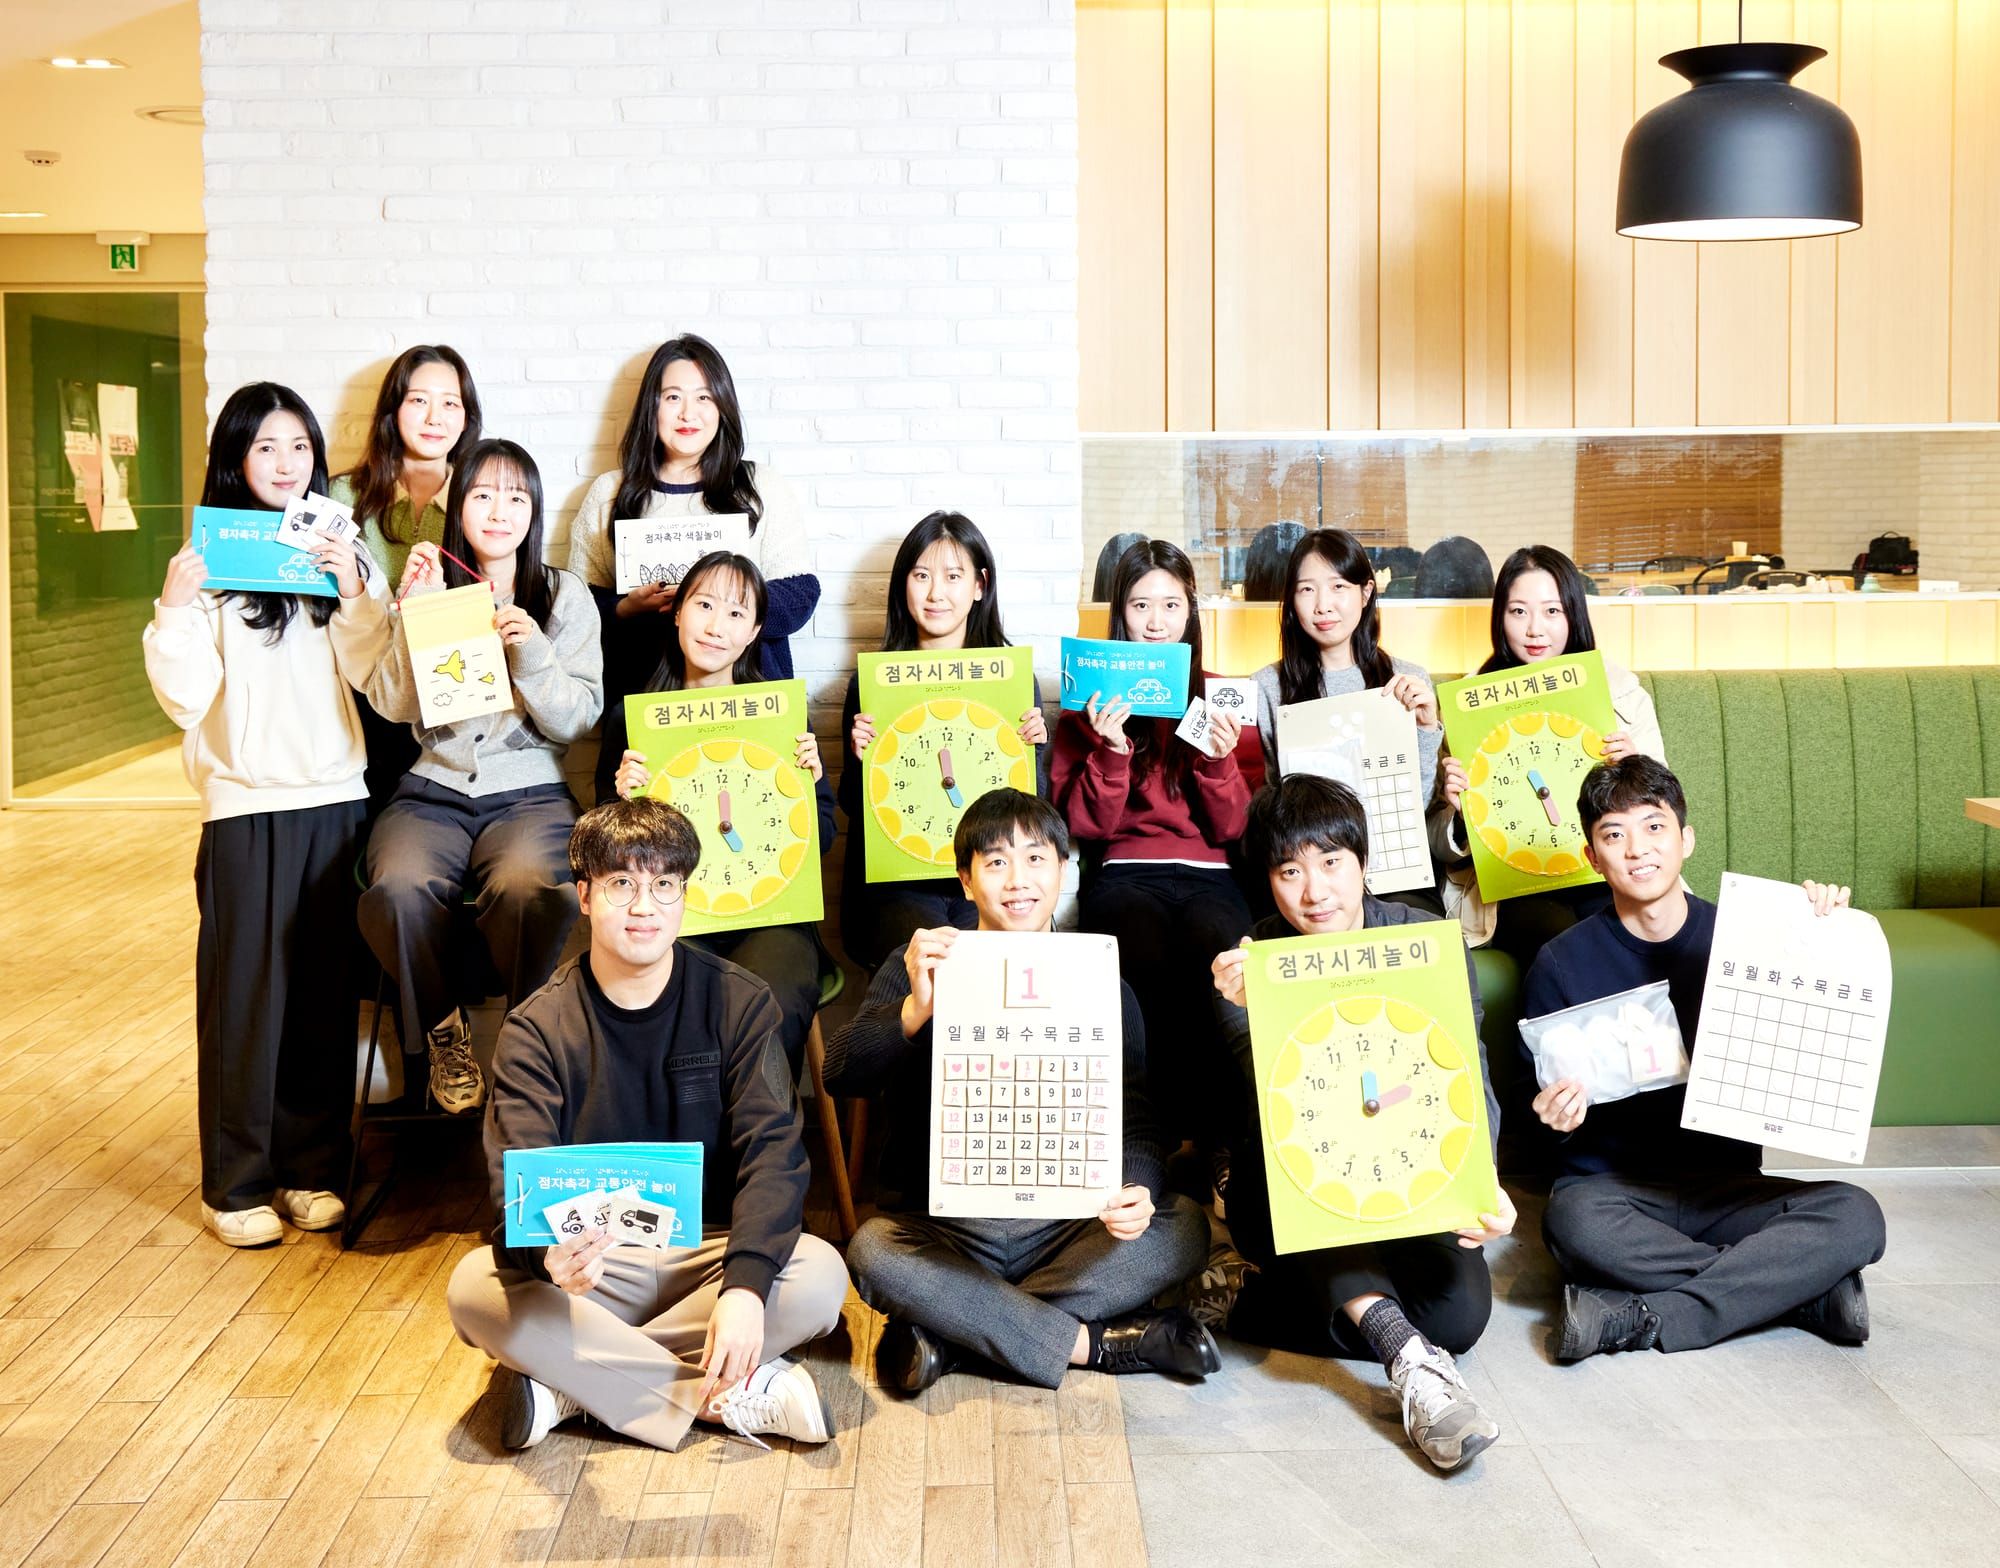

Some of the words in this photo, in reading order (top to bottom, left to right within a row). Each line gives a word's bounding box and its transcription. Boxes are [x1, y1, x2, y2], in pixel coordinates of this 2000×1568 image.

[218, 528, 260, 540] 점자촉각
[645, 532, 682, 544] 점자촉각
[685, 530, 722, 541] 색칠놀이
[1076, 656, 1108, 670] 점자촉각
[1110, 660, 1145, 670] 교통안전
[1148, 660, 1165, 670] 놀이
[885, 660, 1005, 684] 점자시계놀이
[1465, 668, 1579, 707] 점자시계놀이
[654, 695, 780, 726] 점자시계놀이
[942, 732, 953, 741] 12
[968, 737, 972, 746] 1
[919, 740, 930, 749] 11
[1529, 746, 1541, 755] 12
[1555, 748, 1560, 756] 1
[984, 752, 990, 761] 2
[1362, 758, 1371, 769] 목
[1379, 755, 1389, 768] 금
[1397, 753, 1406, 764] 토
[1509, 757, 1520, 766] 11
[904, 759, 916, 767] 10
[1574, 759, 1580, 768] 2
[716, 774, 728, 784] 12
[744, 778, 749, 787] 1
[991, 776, 997, 784] 3
[1498, 776, 1510, 786] 10
[693, 784, 704, 793] 11
[899, 781, 905, 789] 9
[762, 793, 768, 803] 2
[907, 805, 914, 814] 8
[1497, 800, 1503, 809] 9
[770, 818, 776, 827] 3
[925, 821, 931, 830] 7
[1509, 821, 1516, 830] 8
[1571, 824, 1577, 832] 5
[946, 825, 953, 833] 6
[1529, 835, 1535, 844] 7
[1550, 835, 1557, 844] 6
[764, 844, 771, 853] 4
[747, 861, 754, 871] 5
[702, 870, 708, 879] 7
[724, 872, 731, 881] 6
[1277, 940, 1429, 979] 점자시계놀이
[1021, 967, 1039, 1000] 1
[1722, 960, 1735, 977] 일
[1746, 965, 1759, 981] 월
[1766, 970, 1782, 986] 화
[1791, 974, 1805, 990] 수
[1814, 979, 1828, 995] 목
[1837, 983, 1851, 999] 금
[1860, 988, 1873, 1003] 토
[948, 1025, 961, 1042] 일
[972, 1026, 986, 1042] 월
[995, 1026, 1010, 1042] 화
[1020, 1027, 1034, 1042] 수
[1043, 1027, 1058, 1042] 목
[1067, 1027, 1082, 1042] 금
[1091, 1028, 1105, 1042] 토
[1356, 1040, 1371, 1052] 12
[1390, 1045, 1396, 1056] 1
[1328, 1053, 1342, 1064] 11
[1643, 1045, 1661, 1074] 1
[1025, 1061, 1030, 1071] 1
[1049, 1062, 1055, 1073] 2
[1072, 1062, 1078, 1072] 3
[1095, 1060, 1102, 1070] 4
[1413, 1063, 1420, 1075] 2
[1311, 1078, 1326, 1090] 10
[951, 1087, 958, 1097] 5
[975, 1087, 982, 1097] 6
[1000, 1087, 1006, 1097] 7
[1024, 1087, 1030, 1097] 8
[1048, 1088, 1055, 1098] 9
[1071, 1088, 1082, 1098] 10
[1094, 1087, 1104, 1096] 11
[1425, 1095, 1433, 1107] 3
[948, 1113, 959, 1122] 12
[973, 1113, 984, 1123] 13
[997, 1113, 1008, 1123] 14
[1021, 1114, 1032, 1124] 15
[1045, 1114, 1057, 1123] 16
[1071, 1113, 1082, 1122] 17
[1094, 1114, 1105, 1124] 18
[1306, 1110, 1314, 1121] 9
[1419, 1128, 1428, 1140] 4
[948, 1139, 960, 1148] 19
[972, 1139, 984, 1149] 20
[996, 1140, 1007, 1150] 21
[1020, 1140, 1032, 1150] 22
[1044, 1140, 1056, 1150] 23
[1068, 1140, 1080, 1150] 24
[1094, 1141, 1105, 1150] 25
[1321, 1142, 1329, 1154] 8
[1401, 1151, 1408, 1163] 5
[948, 1164, 960, 1173] 26
[972, 1166, 984, 1176] 27
[996, 1166, 1007, 1175] 28
[1020, 1166, 1031, 1175] 29
[1044, 1166, 1056, 1176] 30
[1069, 1166, 1080, 1176] 31
[1345, 1162, 1353, 1174] 7
[1373, 1164, 1381, 1176] 6
[538, 1176, 590, 1190] 점자촉각
[651, 1180, 676, 1195] 놀이
